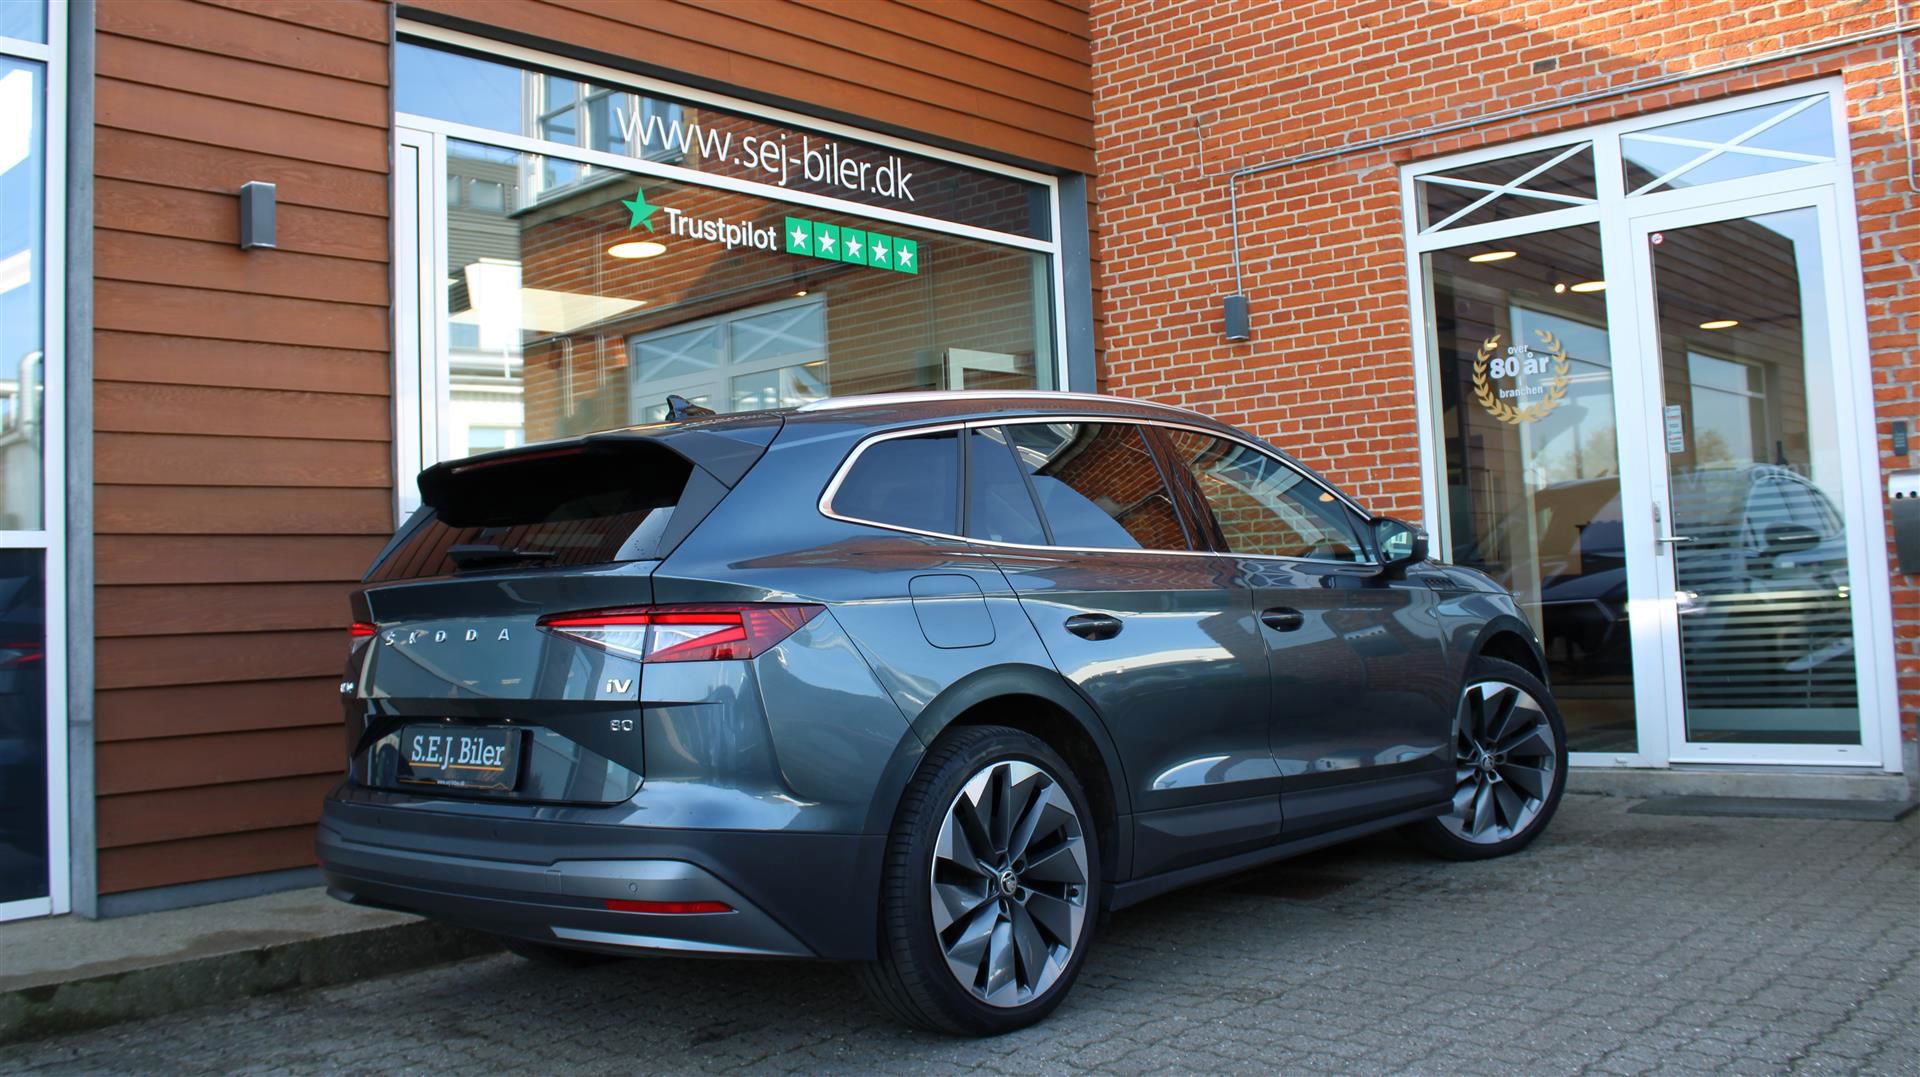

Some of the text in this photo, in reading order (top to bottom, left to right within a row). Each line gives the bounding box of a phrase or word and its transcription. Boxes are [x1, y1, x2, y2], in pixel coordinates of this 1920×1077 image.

[616, 107, 915, 201] www.sej-biler.dk
[663, 207, 777, 251] Trustpilot
[1490, 351, 1550, 379] 80 år
[1507, 344, 1528, 354] over
[1499, 385, 1543, 398] branchen
[411, 735, 505, 771] S.E.J. Biler
